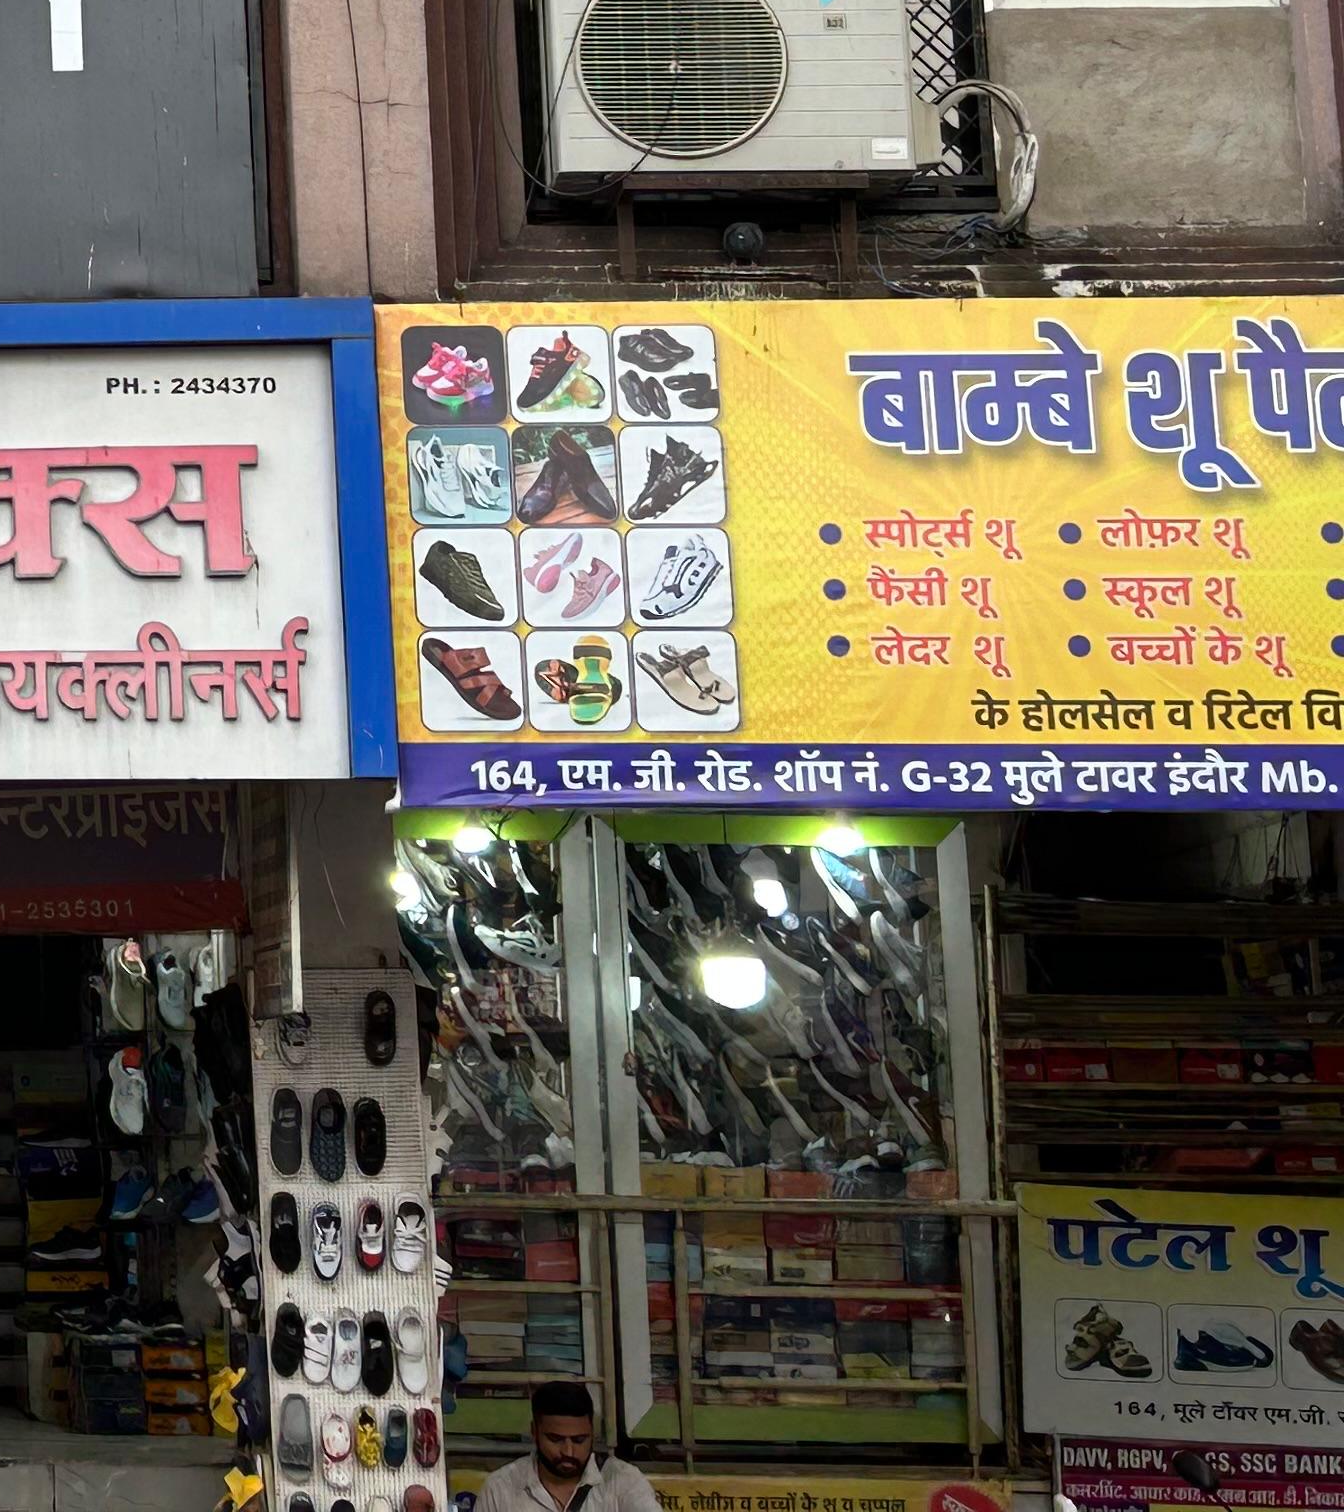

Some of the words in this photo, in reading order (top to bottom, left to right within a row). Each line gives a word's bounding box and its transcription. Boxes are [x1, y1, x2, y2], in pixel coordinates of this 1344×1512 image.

[169, 375, 278, 395] 2434370
[846, 316, 1102, 455] बाम्बे
[1123, 349, 1261, 493] शू
[984, 518, 1024, 561] शू
[1213, 517, 1252, 560] शू
[865, 565, 949, 609] फैंसी
[960, 577, 999, 619] शू
[1101, 576, 1194, 619] स्कूल
[1204, 576, 1243, 619] शू
[871, 625, 951, 667] लेदर
[973, 634, 1012, 678] शू
[1106, 625, 1196, 667] बच्चों
[1203, 625, 1243, 665] के
[1255, 634, 1295, 678] शू
[972, 689, 1010, 731] के
[1018, 689, 1155, 732] होलसेल
[1164, 699, 1193, 731] व
[1202, 689, 1292, 731] रिटेल
[470, 760, 548, 796] 164,
[557, 759, 622, 792] एम.
[631, 749, 686, 792] जी.
[694, 750, 763, 792] रोड.
[775, 750, 846, 792] शॉप
[851, 750, 890, 792] नं.
[902, 761, 993, 792] G-32
[1001, 750, 1065, 805] मुले
[1070, 758, 1159, 793] टावर
[1164, 748, 1249, 796] इंदौर
[1262, 758, 1339, 794] Mb.
[1046, 1199, 1236, 1274] पटेल
[1114, 1400, 1166, 1421] 164,
[1063, 1445, 1113, 1471] DAVV,
[1240, 1452, 1278, 1474] SSC
